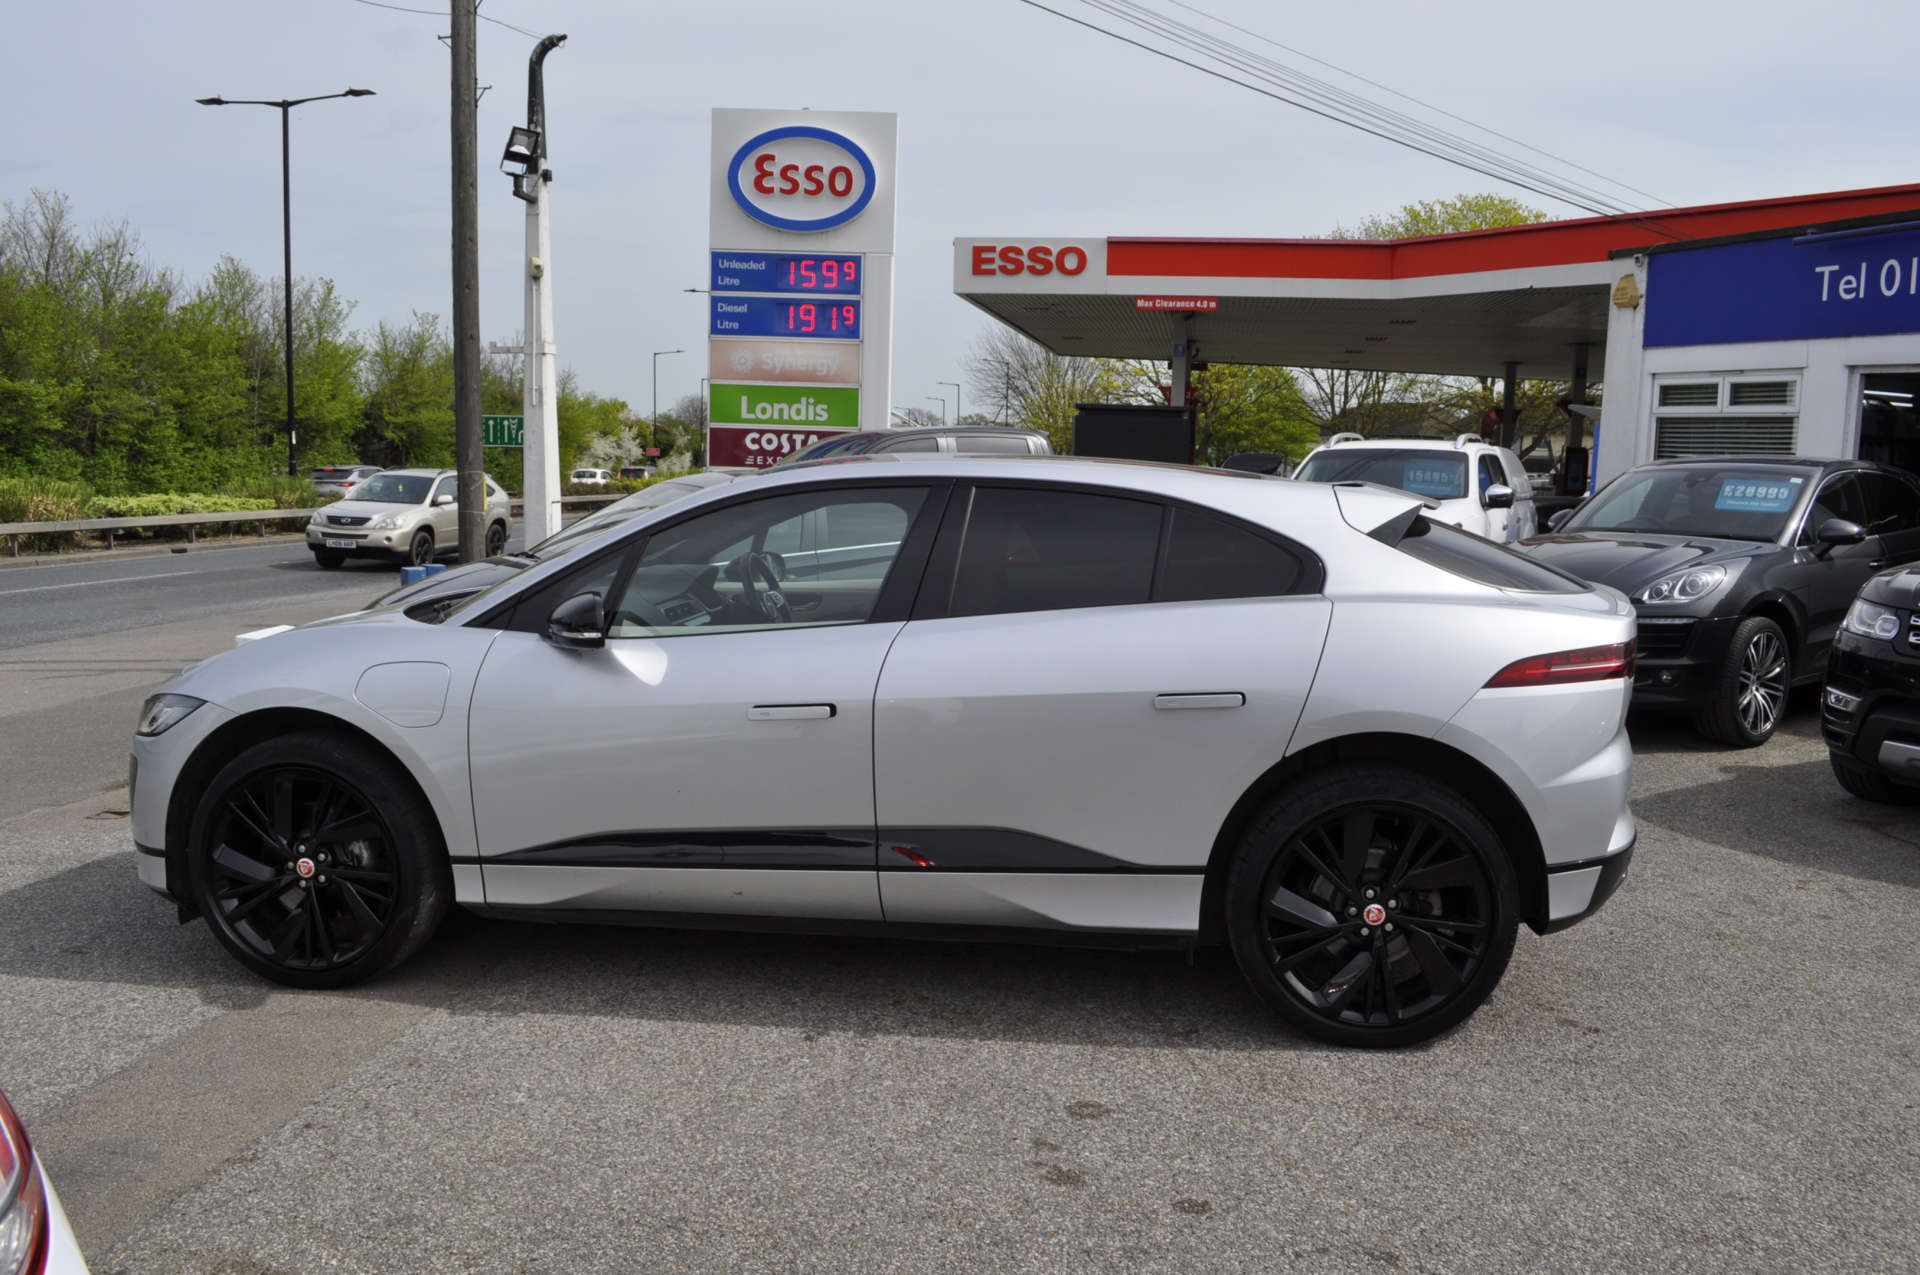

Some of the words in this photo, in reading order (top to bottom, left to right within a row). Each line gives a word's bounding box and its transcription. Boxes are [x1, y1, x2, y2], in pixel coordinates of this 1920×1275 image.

[718, 258, 766, 271] Unleaded
[971, 245, 1088, 276] ESSO
[717, 275, 740, 287] Litre
[1815, 262, 1867, 302] Tel
[717, 302, 748, 313] Diesel
[1137, 299, 1153, 308] Max
[1155, 299, 1195, 309] Clearance
[717, 319, 740, 330] Litre
[761, 351, 841, 377] Synergy
[740, 395, 829, 422] Londis
